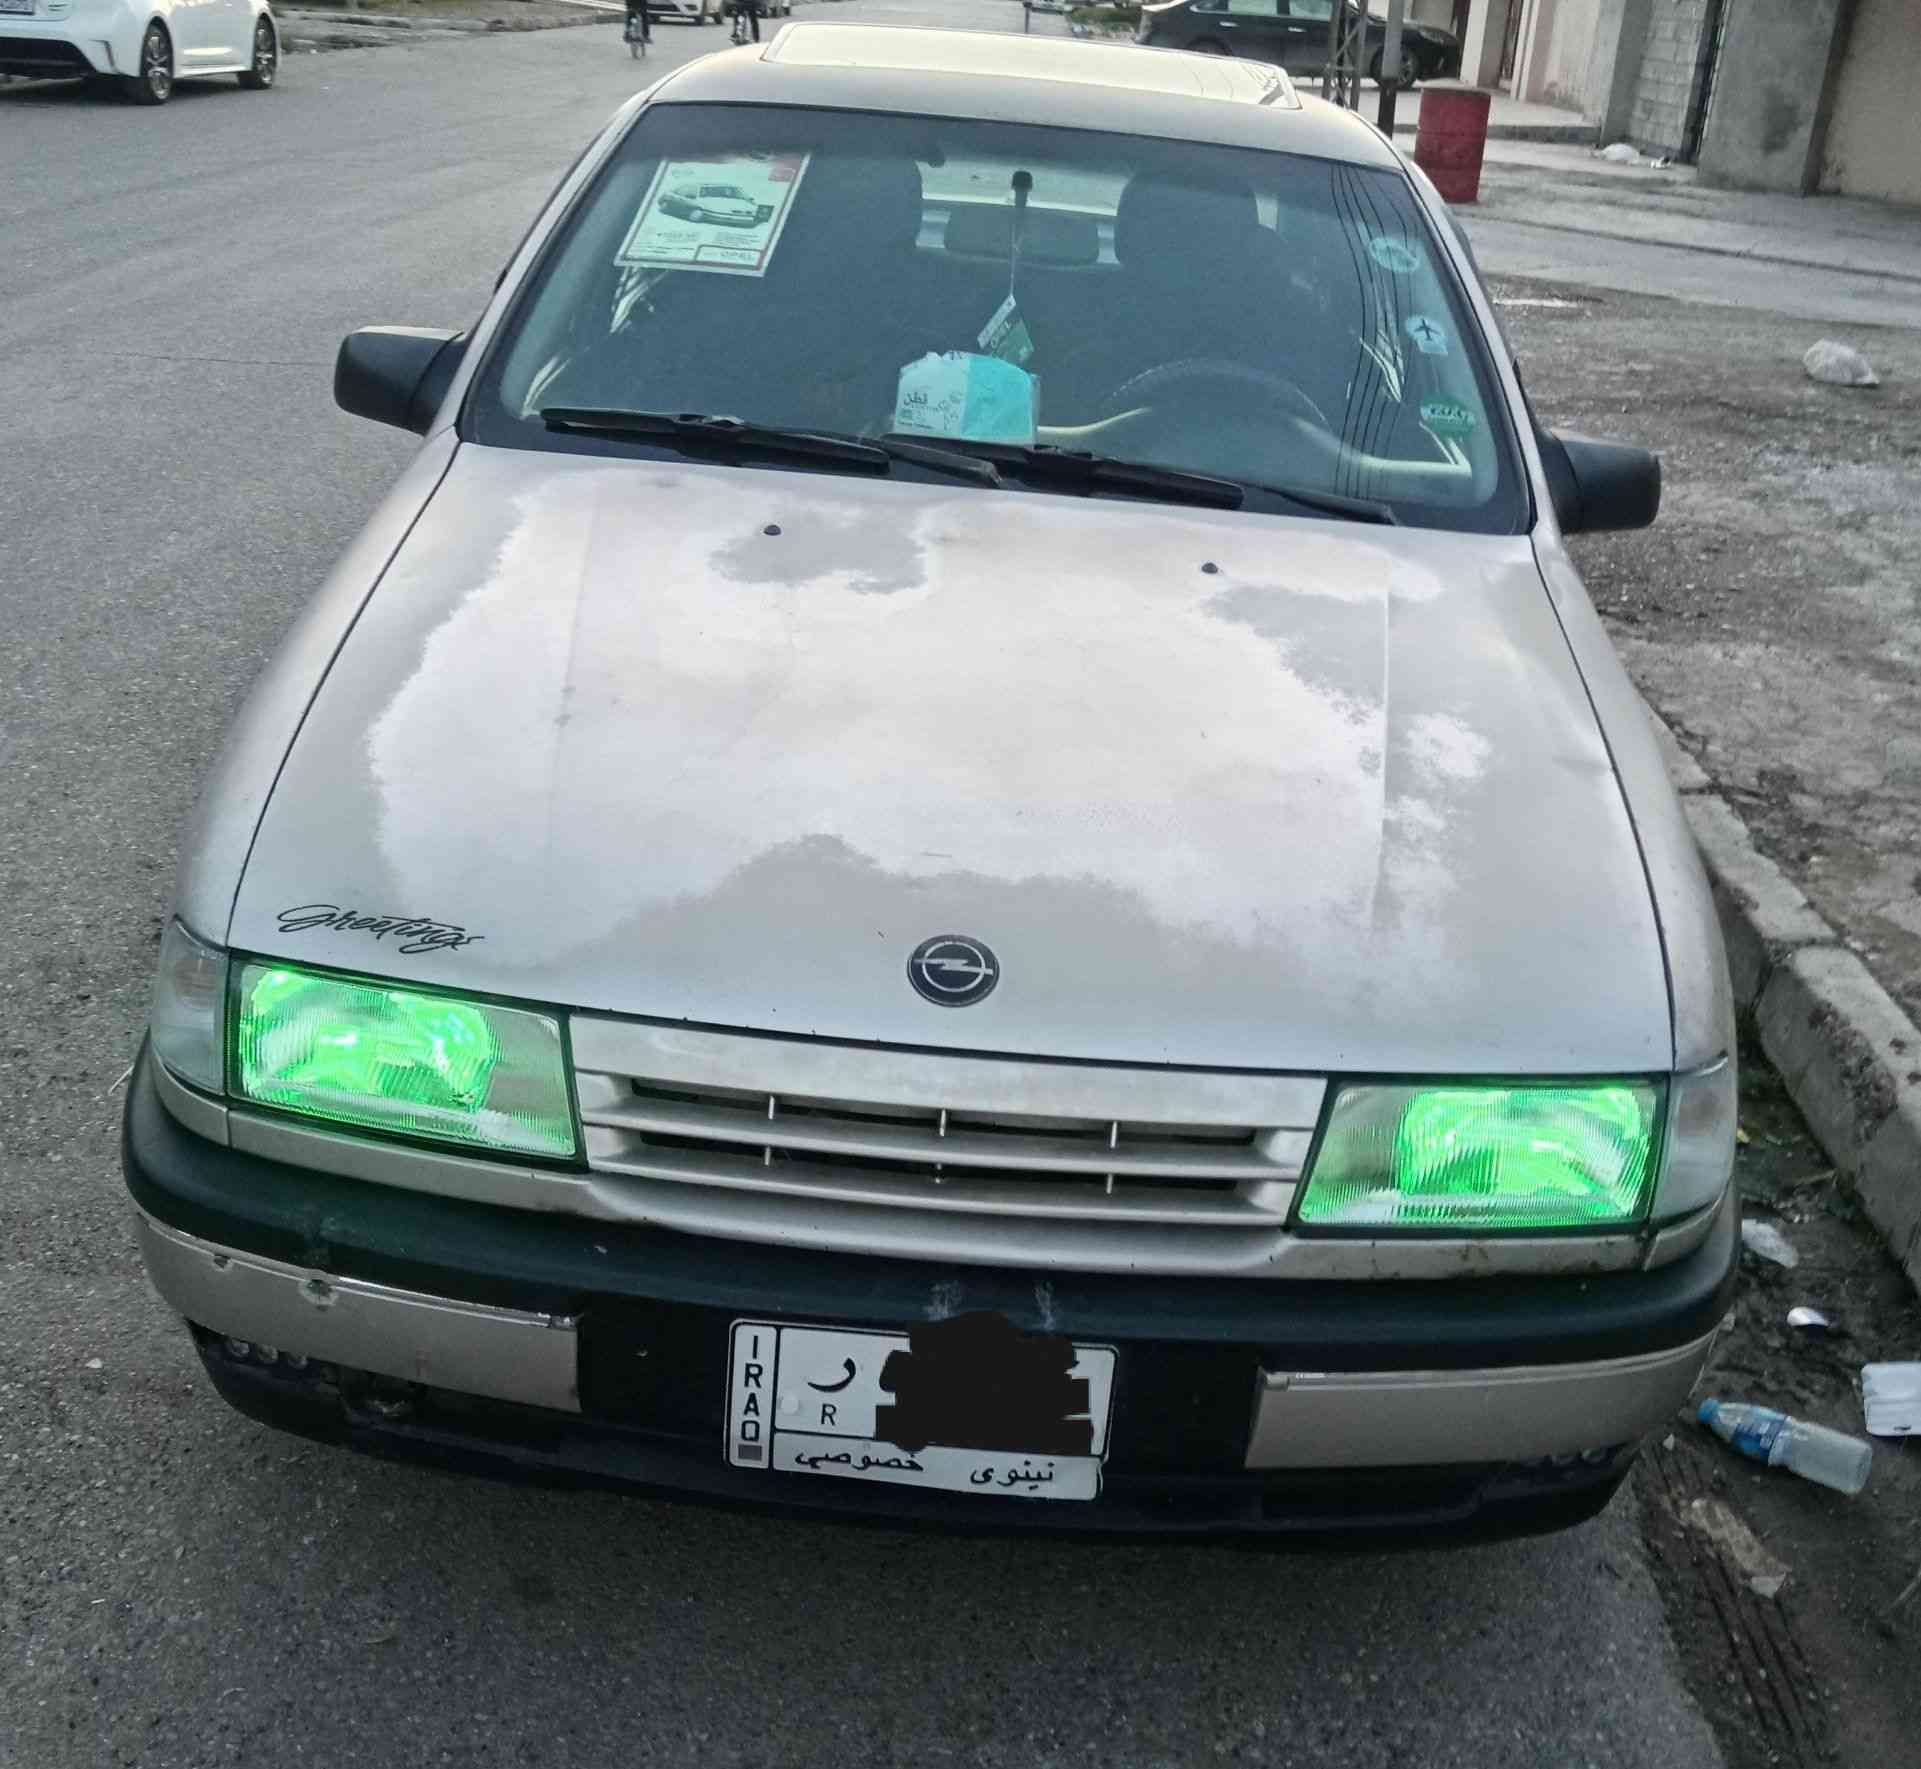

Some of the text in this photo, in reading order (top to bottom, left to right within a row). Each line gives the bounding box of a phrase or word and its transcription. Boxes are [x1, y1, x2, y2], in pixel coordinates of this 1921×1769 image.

[741, 1335, 763, 1441] IRAQ
[807, 1357, 856, 1393] ر
[821, 1403, 836, 1426] R
